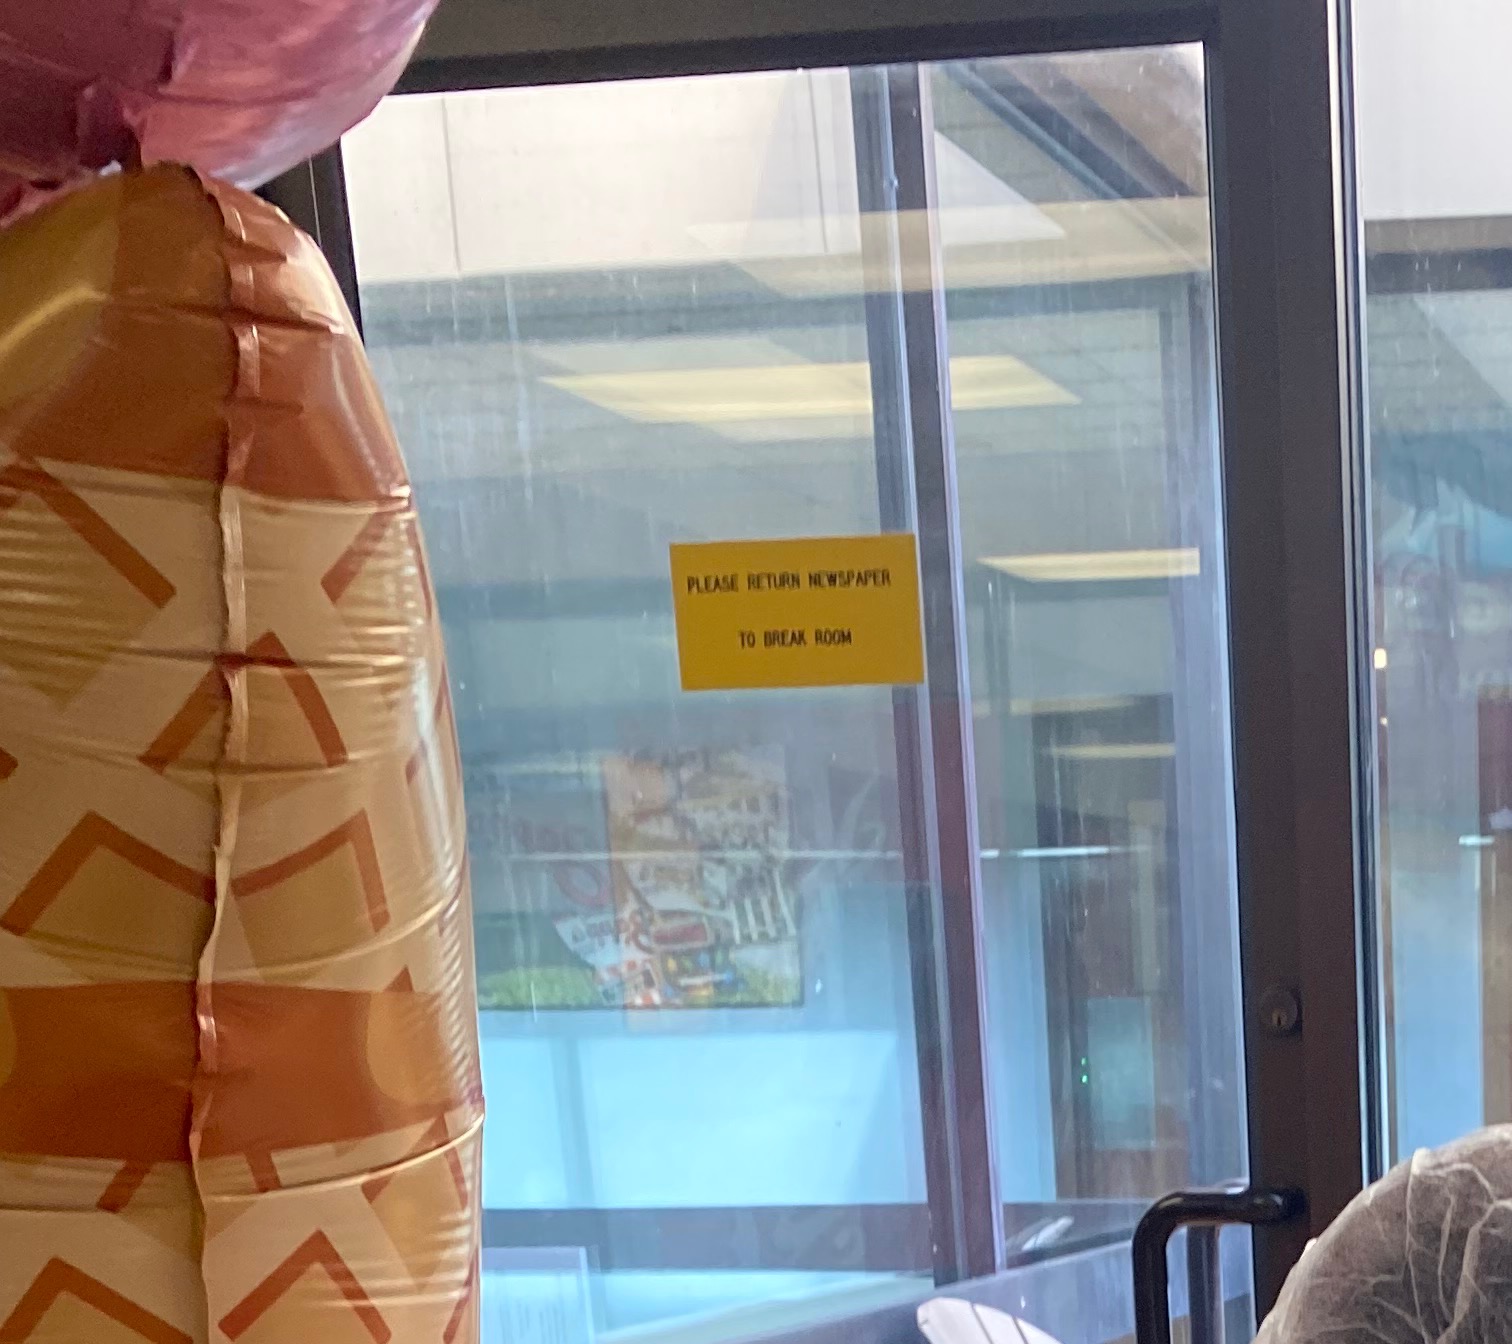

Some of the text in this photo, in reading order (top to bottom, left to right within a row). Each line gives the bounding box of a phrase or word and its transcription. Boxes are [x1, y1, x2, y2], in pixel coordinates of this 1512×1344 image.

[687, 568, 891, 594] PLEASE RETURN NEWSPAPER
[738, 628, 852, 649] TO BREAK ROOM
